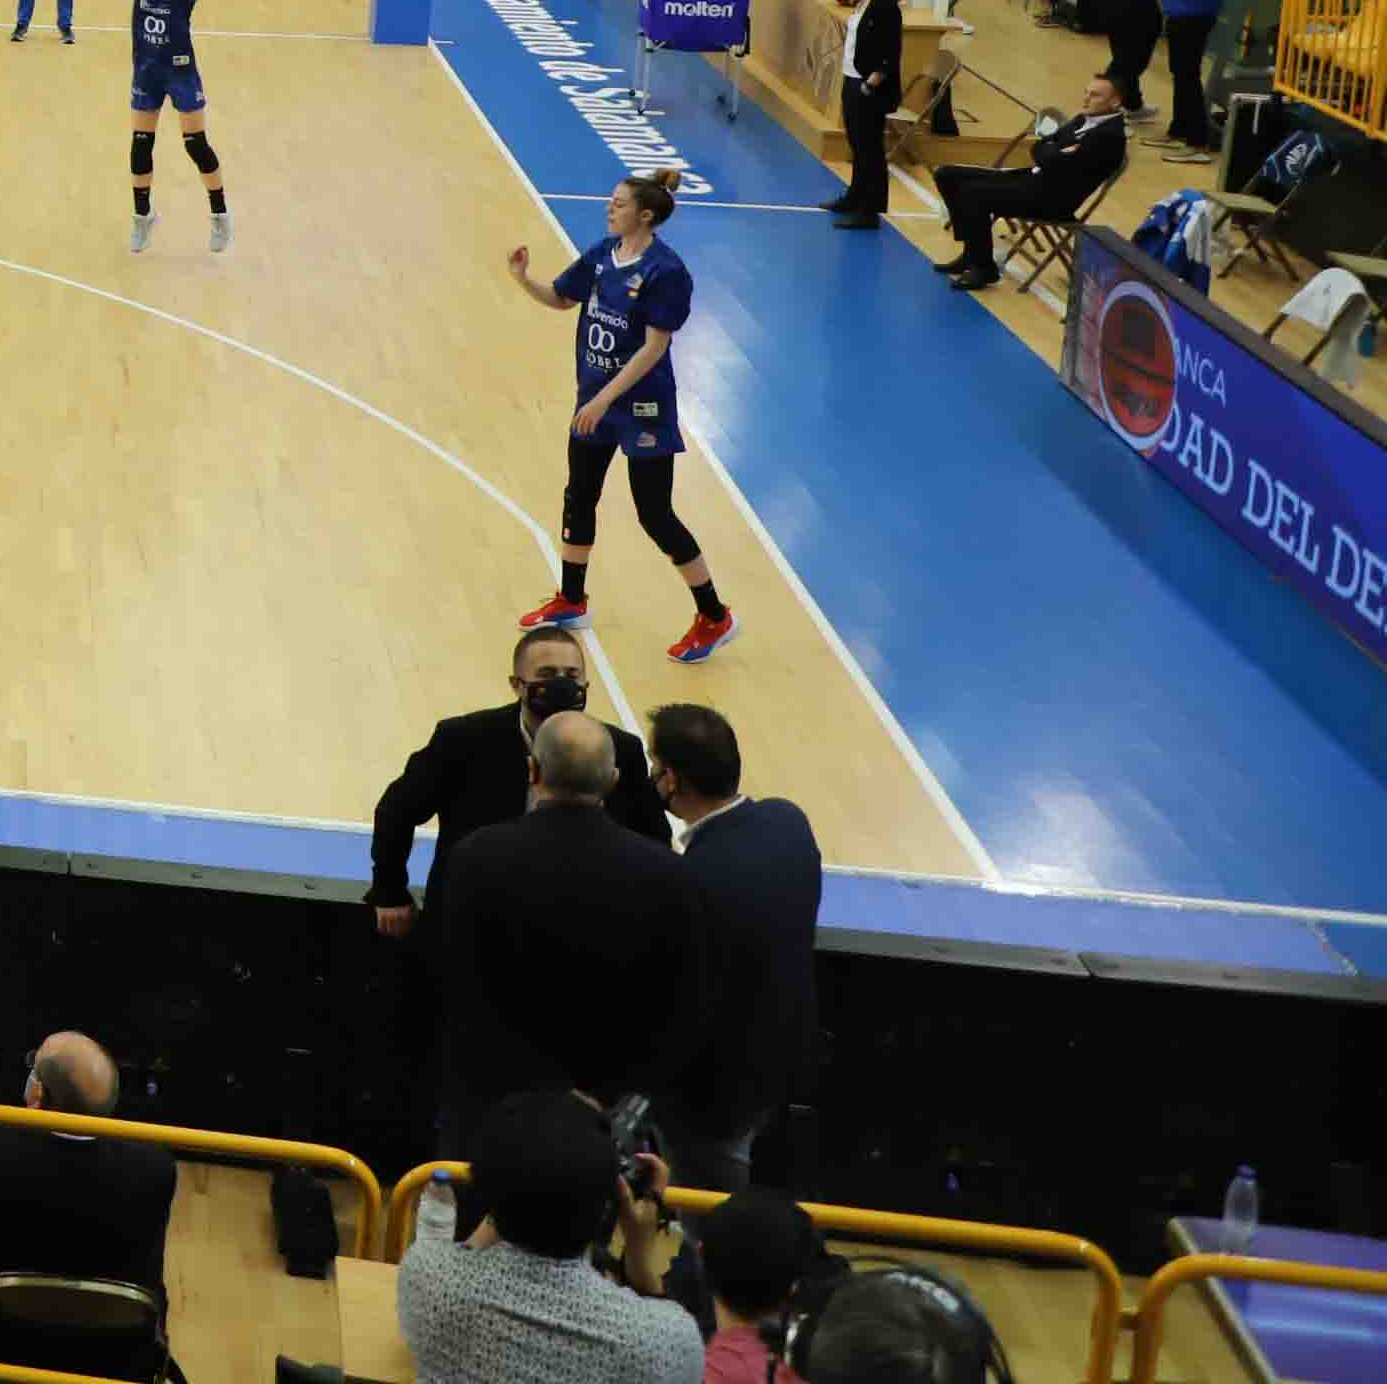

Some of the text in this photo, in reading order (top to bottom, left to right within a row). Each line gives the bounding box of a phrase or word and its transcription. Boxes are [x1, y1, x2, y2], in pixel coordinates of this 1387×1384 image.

[664, 0, 734, 19] molten
[539, 60, 626, 82] de
[1242, 459, 1320, 575] DEL
